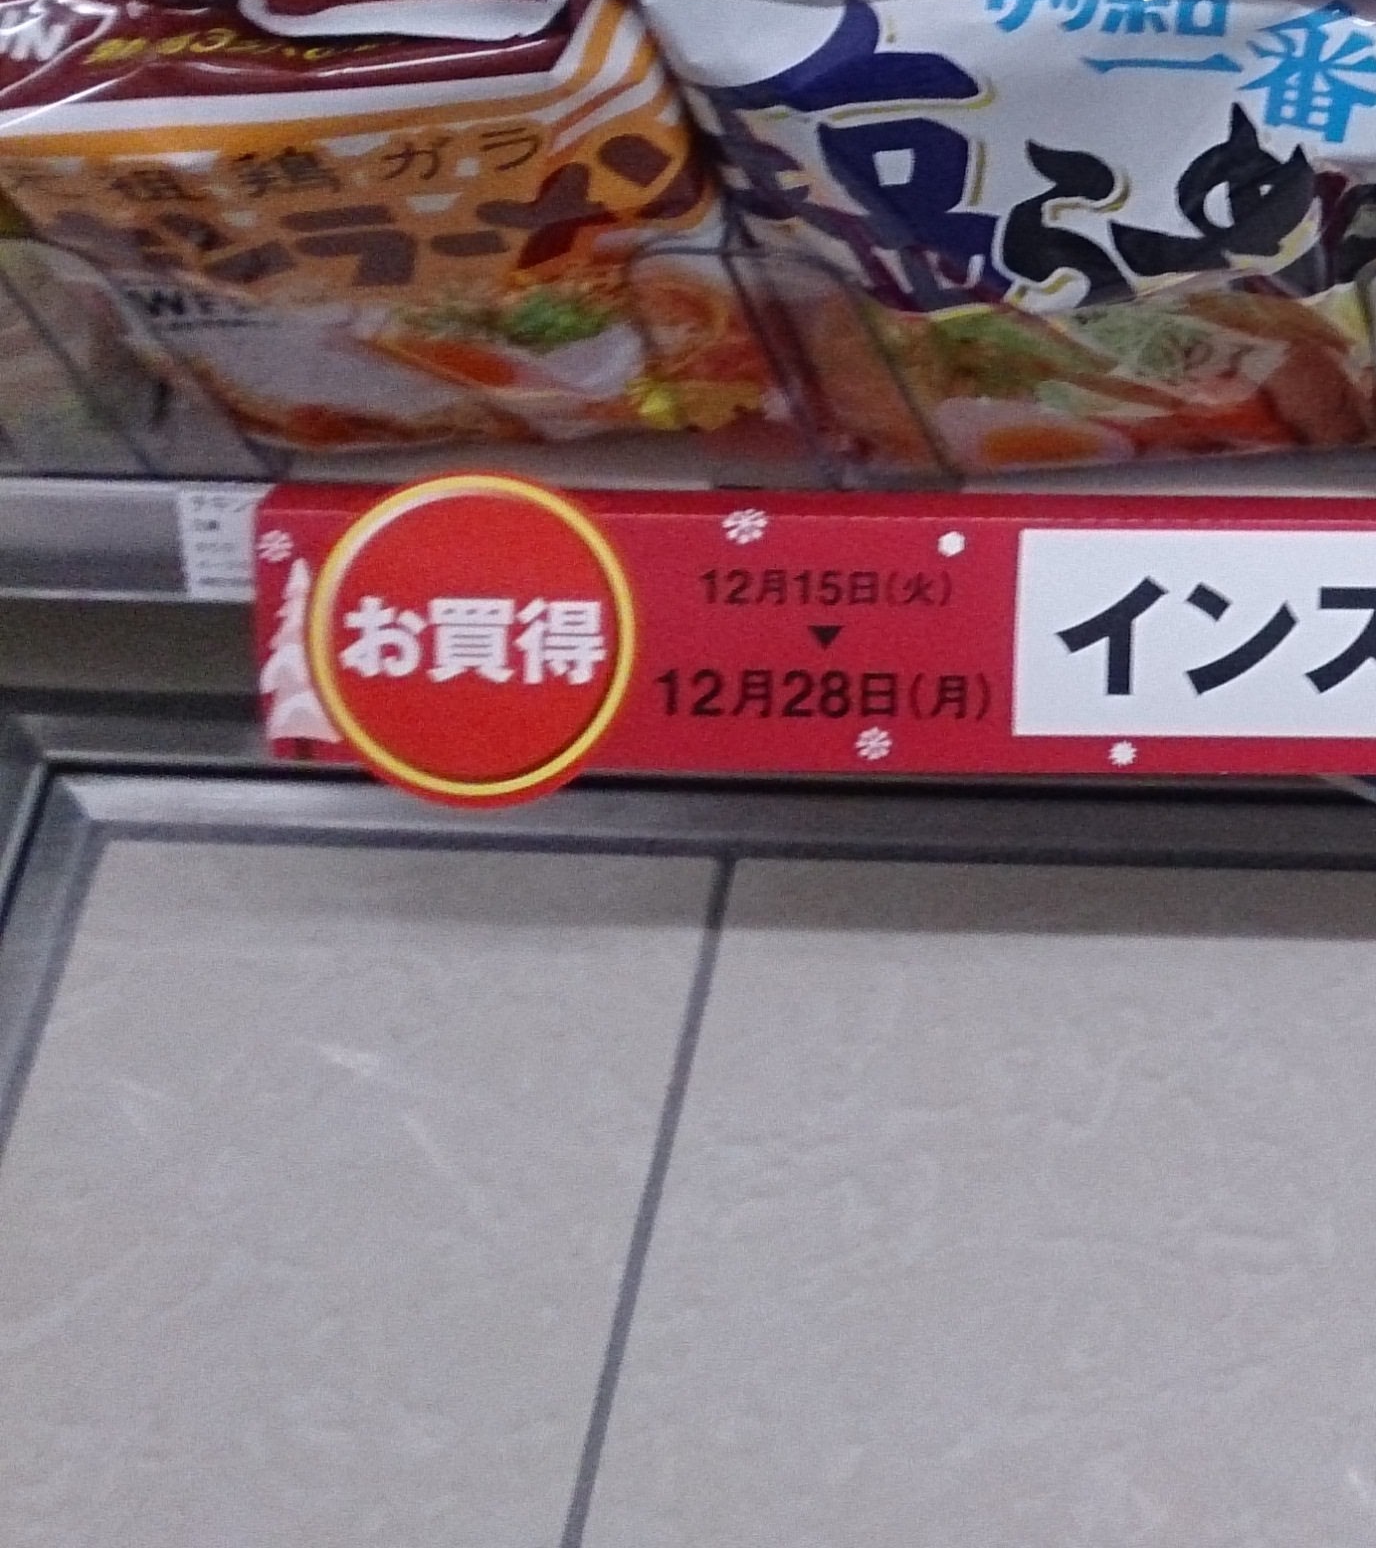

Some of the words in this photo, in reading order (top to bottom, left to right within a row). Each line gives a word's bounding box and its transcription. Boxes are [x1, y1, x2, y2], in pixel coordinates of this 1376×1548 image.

[700, 567, 954, 609] 12月15日(火)
[341, 595, 607, 685] お買得
[655, 669, 993, 722] 12月28日(月)
